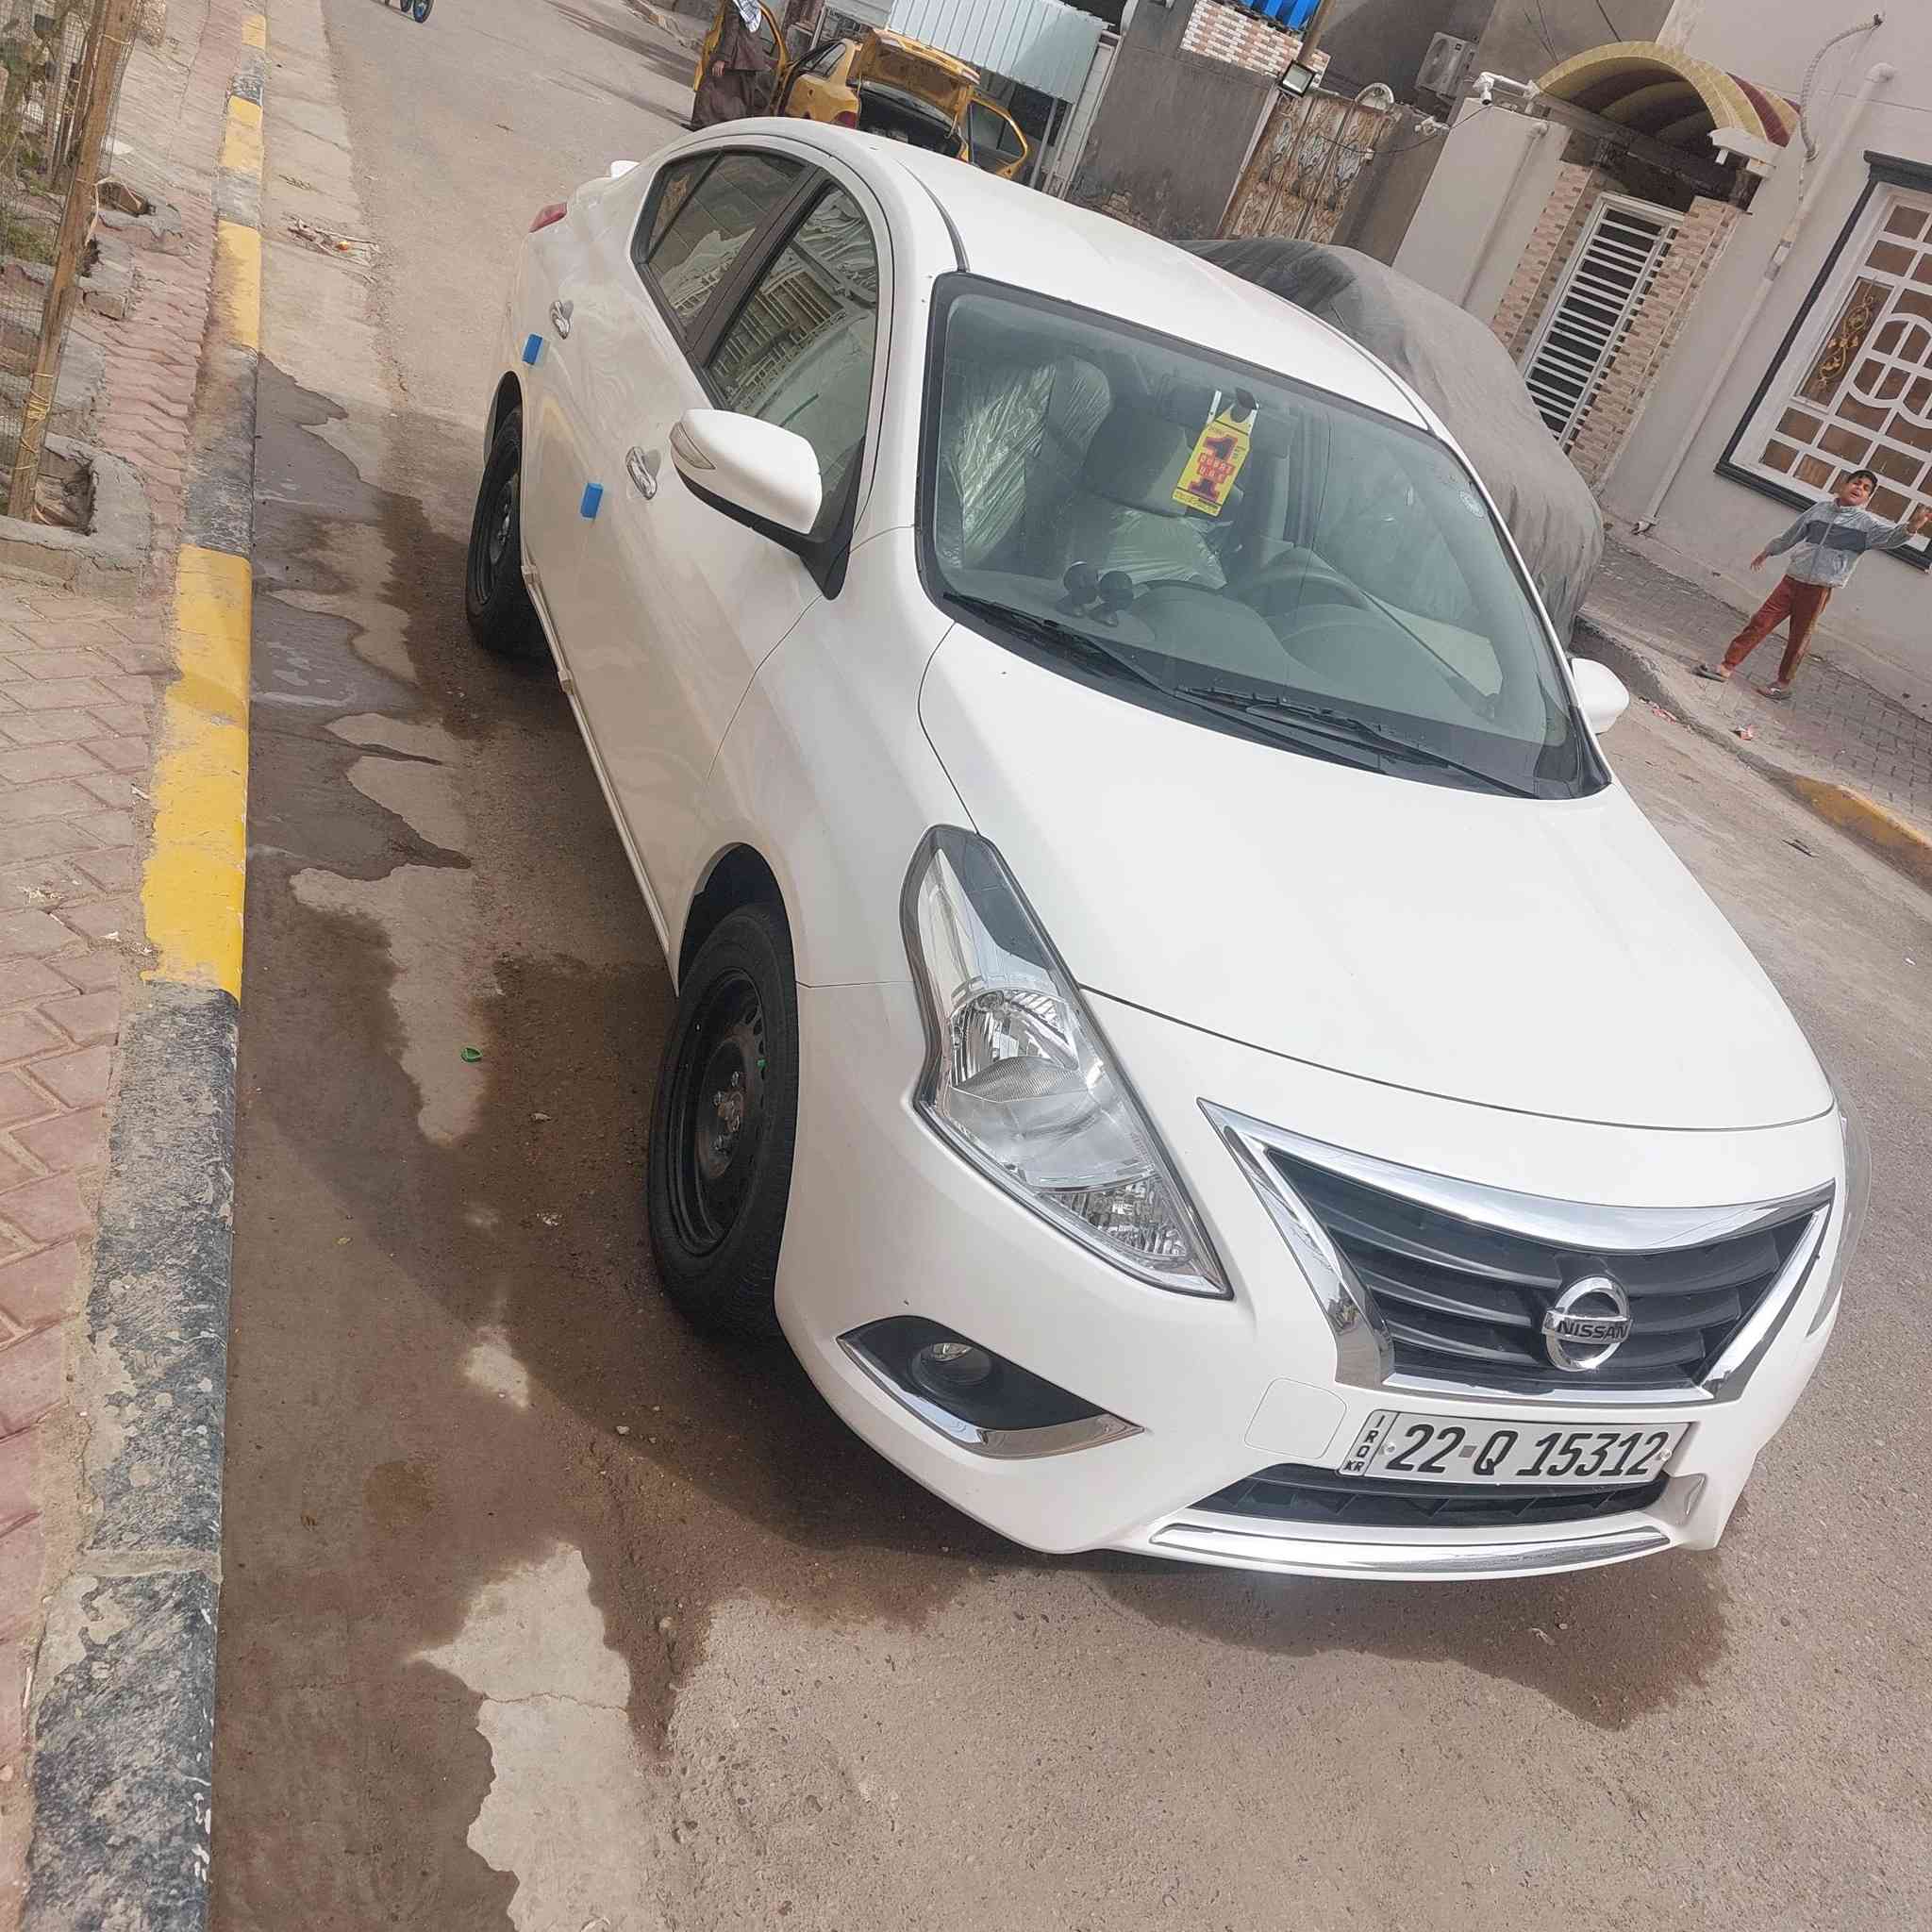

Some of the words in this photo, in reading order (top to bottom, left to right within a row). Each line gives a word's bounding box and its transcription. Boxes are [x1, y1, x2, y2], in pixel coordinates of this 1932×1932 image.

[1557, 1320, 1628, 1339] NISSAN
[1386, 1424, 1466, 1474] 22
[1473, 1430, 1519, 1475] Q
[1516, 1432, 1670, 1476] 15312
[1343, 1459, 1365, 1472] KR
